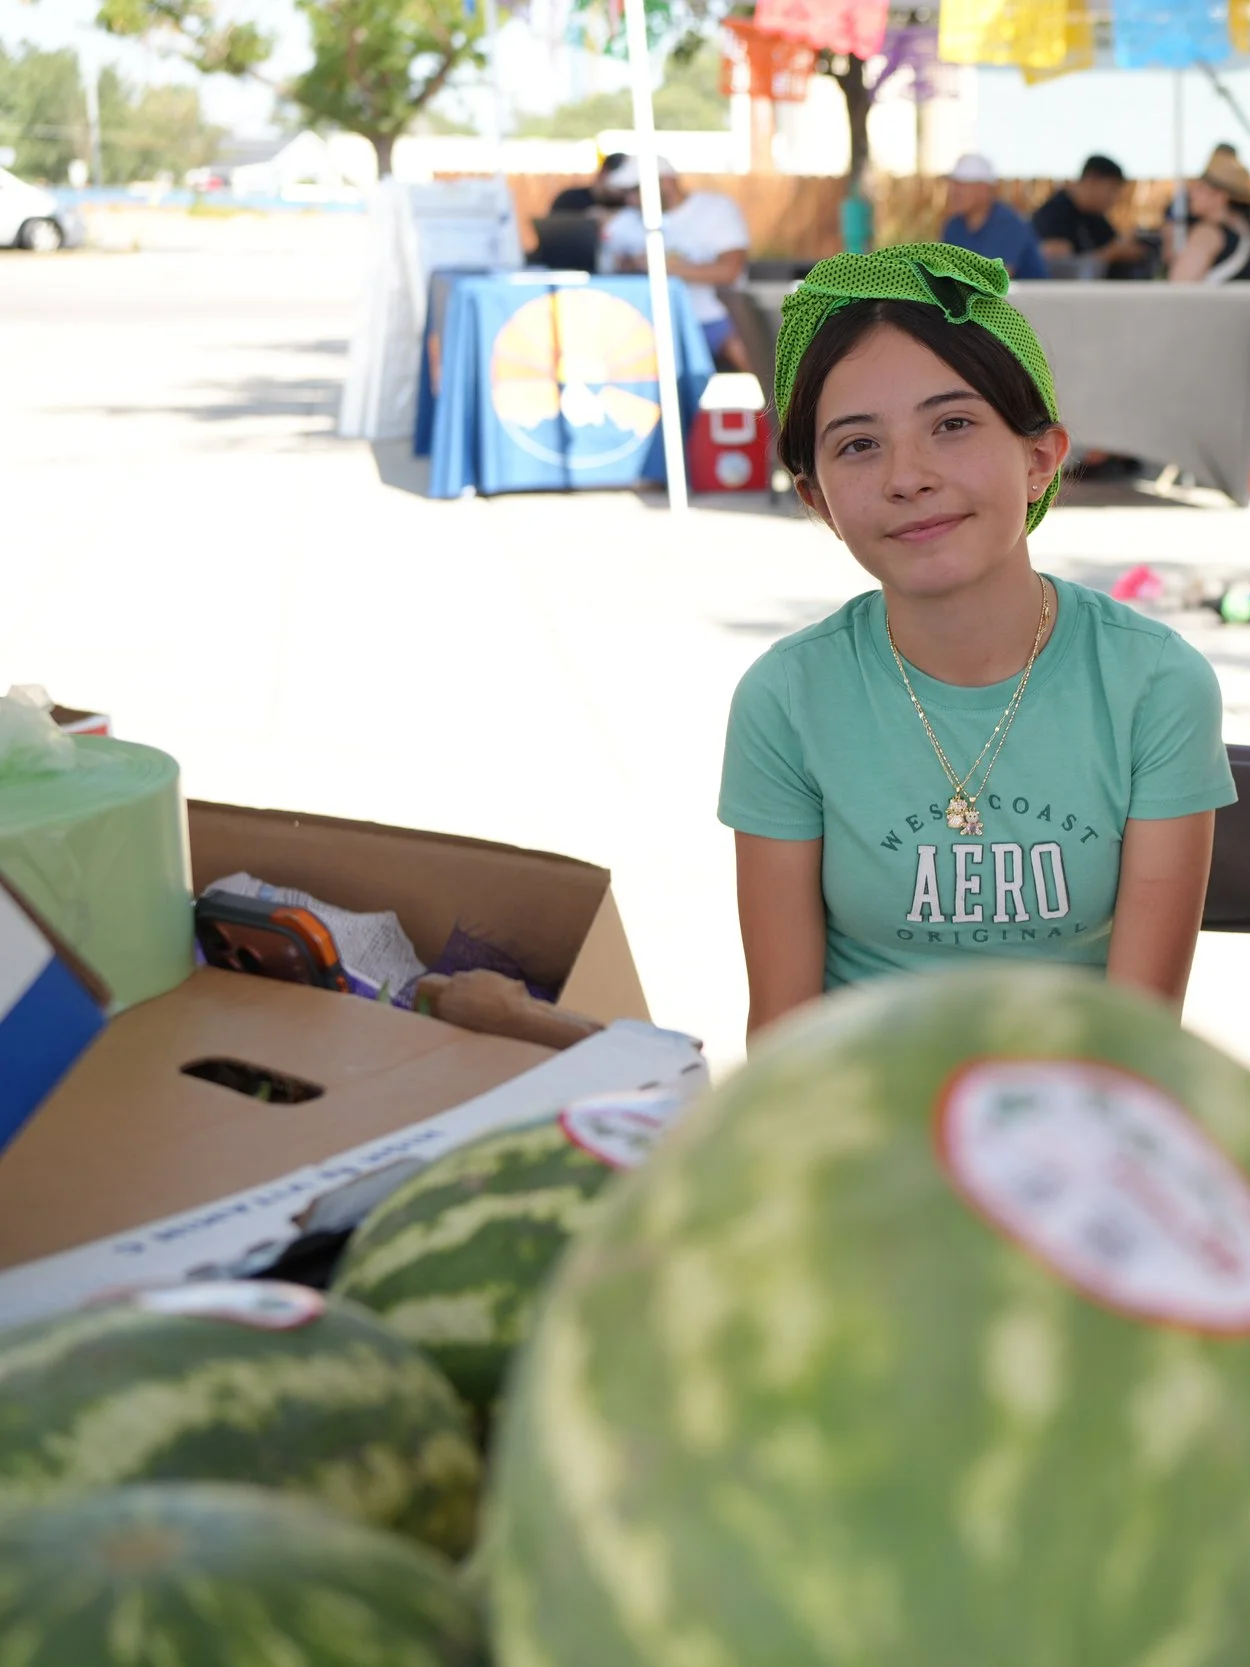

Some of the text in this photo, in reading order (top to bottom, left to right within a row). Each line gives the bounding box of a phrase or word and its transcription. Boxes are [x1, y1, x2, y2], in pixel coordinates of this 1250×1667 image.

[881, 794, 1099, 851] WES COAST
[906, 841, 1070, 922] AERO
[897, 922, 1087, 944] ORIGINAL
